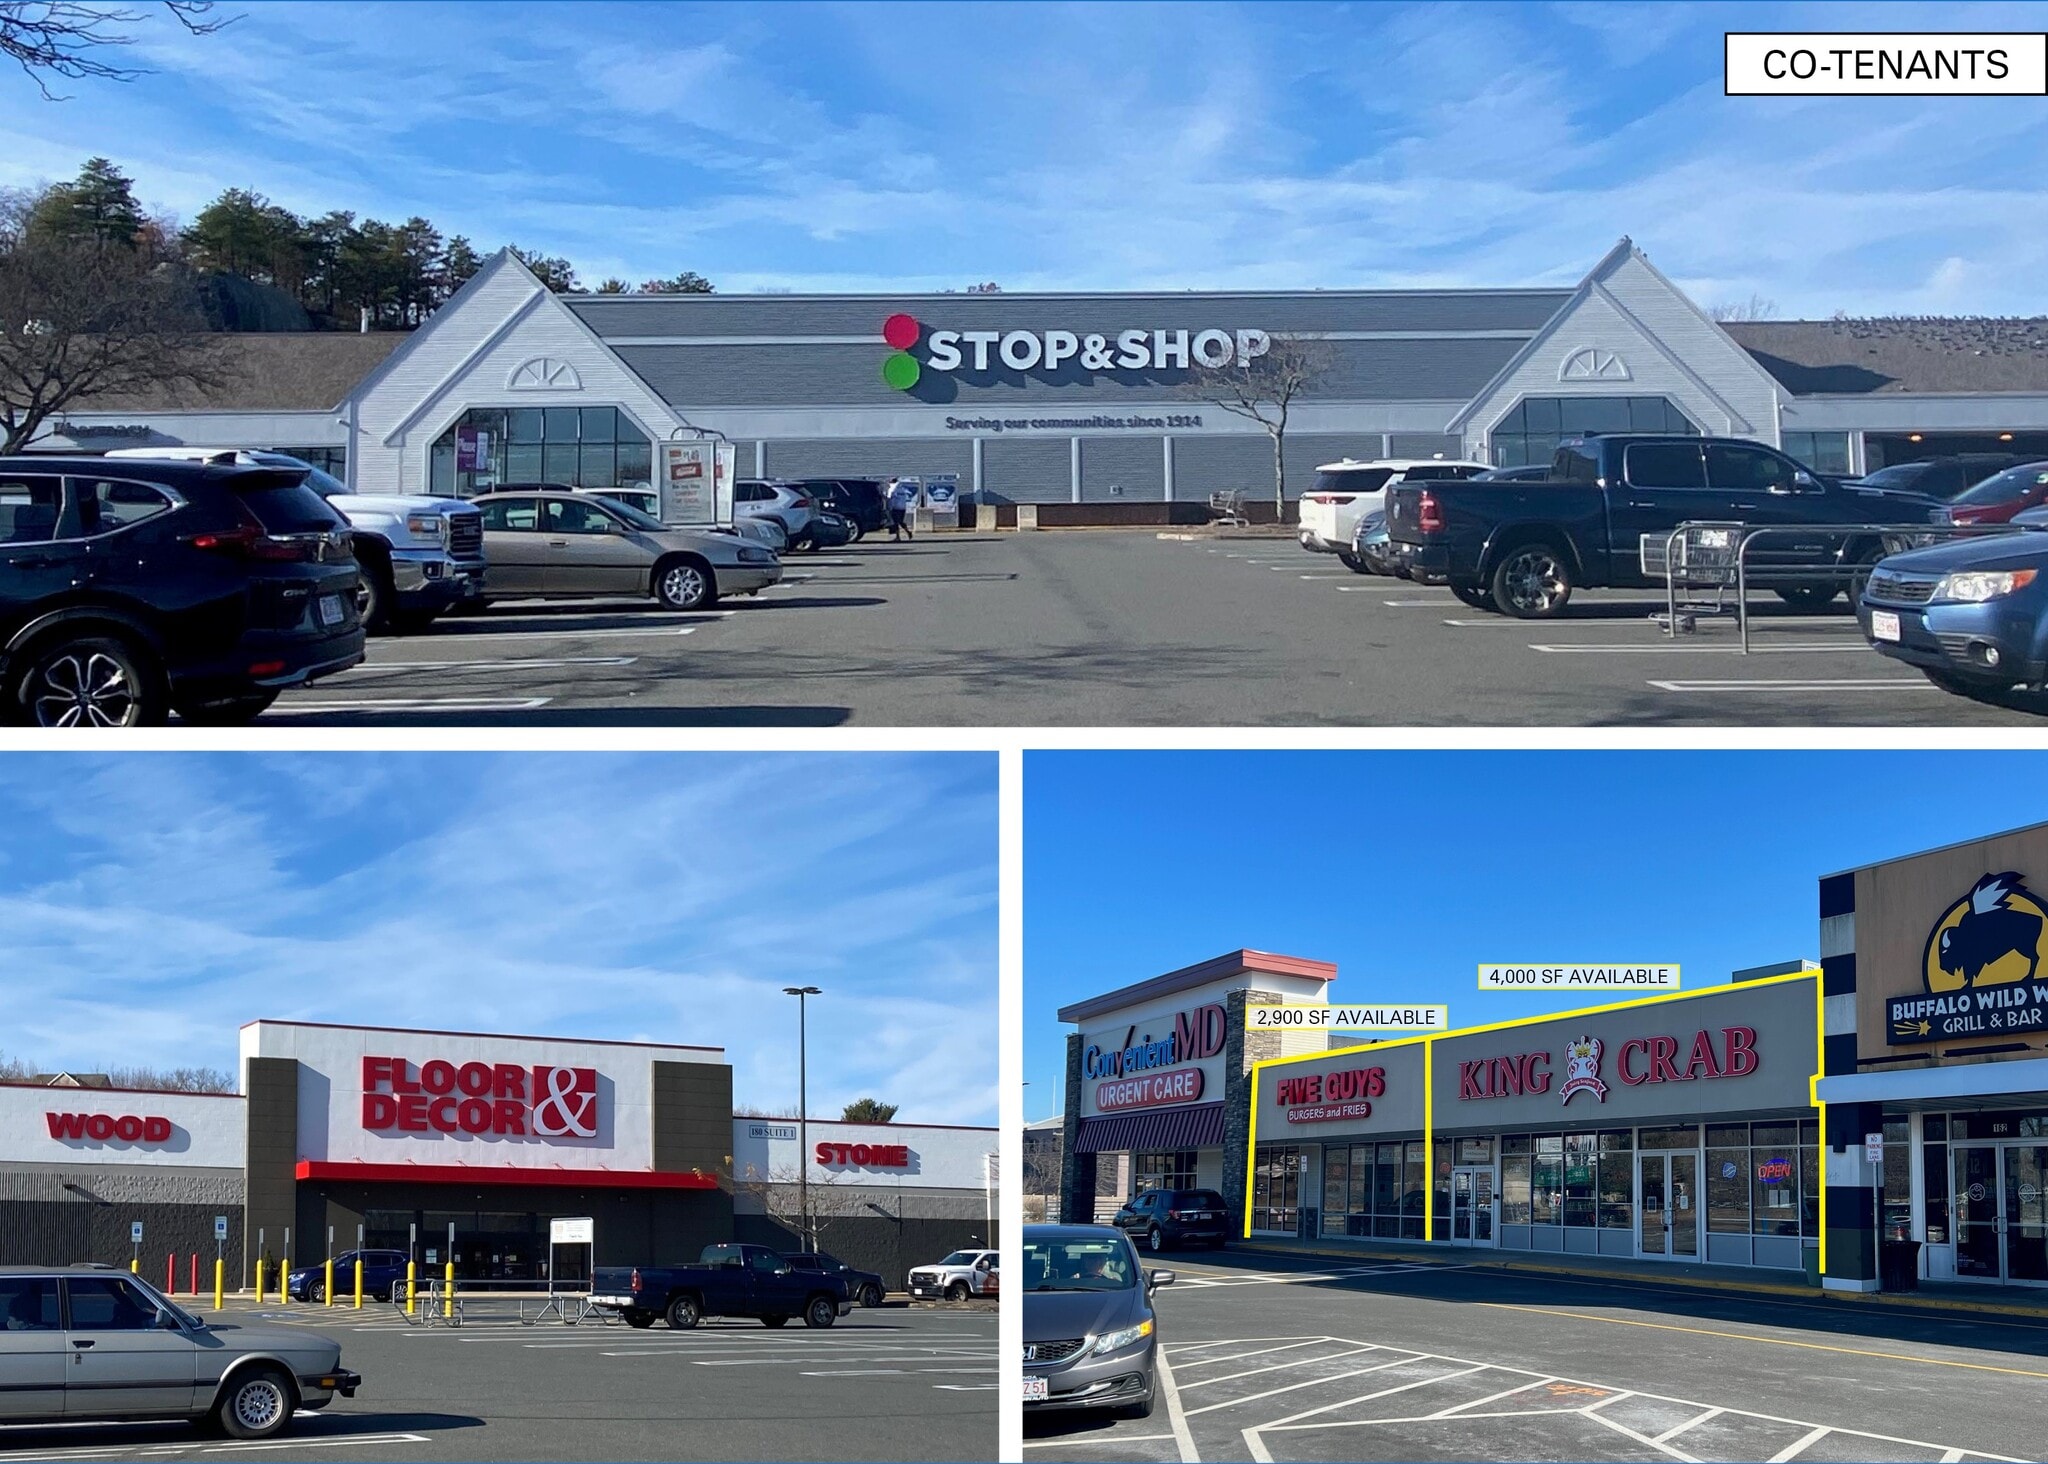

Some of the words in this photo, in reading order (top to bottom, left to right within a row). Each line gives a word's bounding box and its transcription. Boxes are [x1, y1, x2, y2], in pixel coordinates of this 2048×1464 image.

[928, 329, 1271, 370] STOP&SHOP
[945, 416, 1002, 432] Serving
[1004, 419, 1029, 429] our
[1031, 415, 1126, 429] communities
[1126, 415, 1164, 429] since
[1166, 415, 1203, 428] 1914
[1892, 994, 1971, 1021] BUFFALO
[1975, 987, 2027, 1011] WILD
[1942, 1014, 1985, 1033] GRILL
[1989, 1012, 2002, 1029] &
[2007, 1008, 2043, 1027] BAR
[362, 1055, 526, 1099] FLOOR
[1457, 1051, 1553, 1100] KING
[1616, 1026, 1760, 1086] CRAB
[1100, 1079, 1151, 1107] URGENT
[1154, 1073, 1194, 1100] CARE
[1276, 1075, 1322, 1106] FIVE
[1324, 1066, 1386, 1101] GUYS
[362, 1093, 526, 1135] DECOR
[532, 1066, 597, 1137] &
[1288, 1107, 1325, 1121] BURGERS
[1326, 1106, 1341, 1118] and
[1342, 1103, 1367, 1116] FRIES
[46, 1112, 171, 1141] WOOD
[751, 1127, 763, 1137] 180
[764, 1127, 789, 1138] SUITE
[790, 1128, 795, 1138] 1
[816, 1142, 909, 1167] STONE
[1757, 1164, 1792, 1179] OPEN
[1023, 1382, 1030, 1395] Z
[1032, 1381, 1047, 1394] 51
